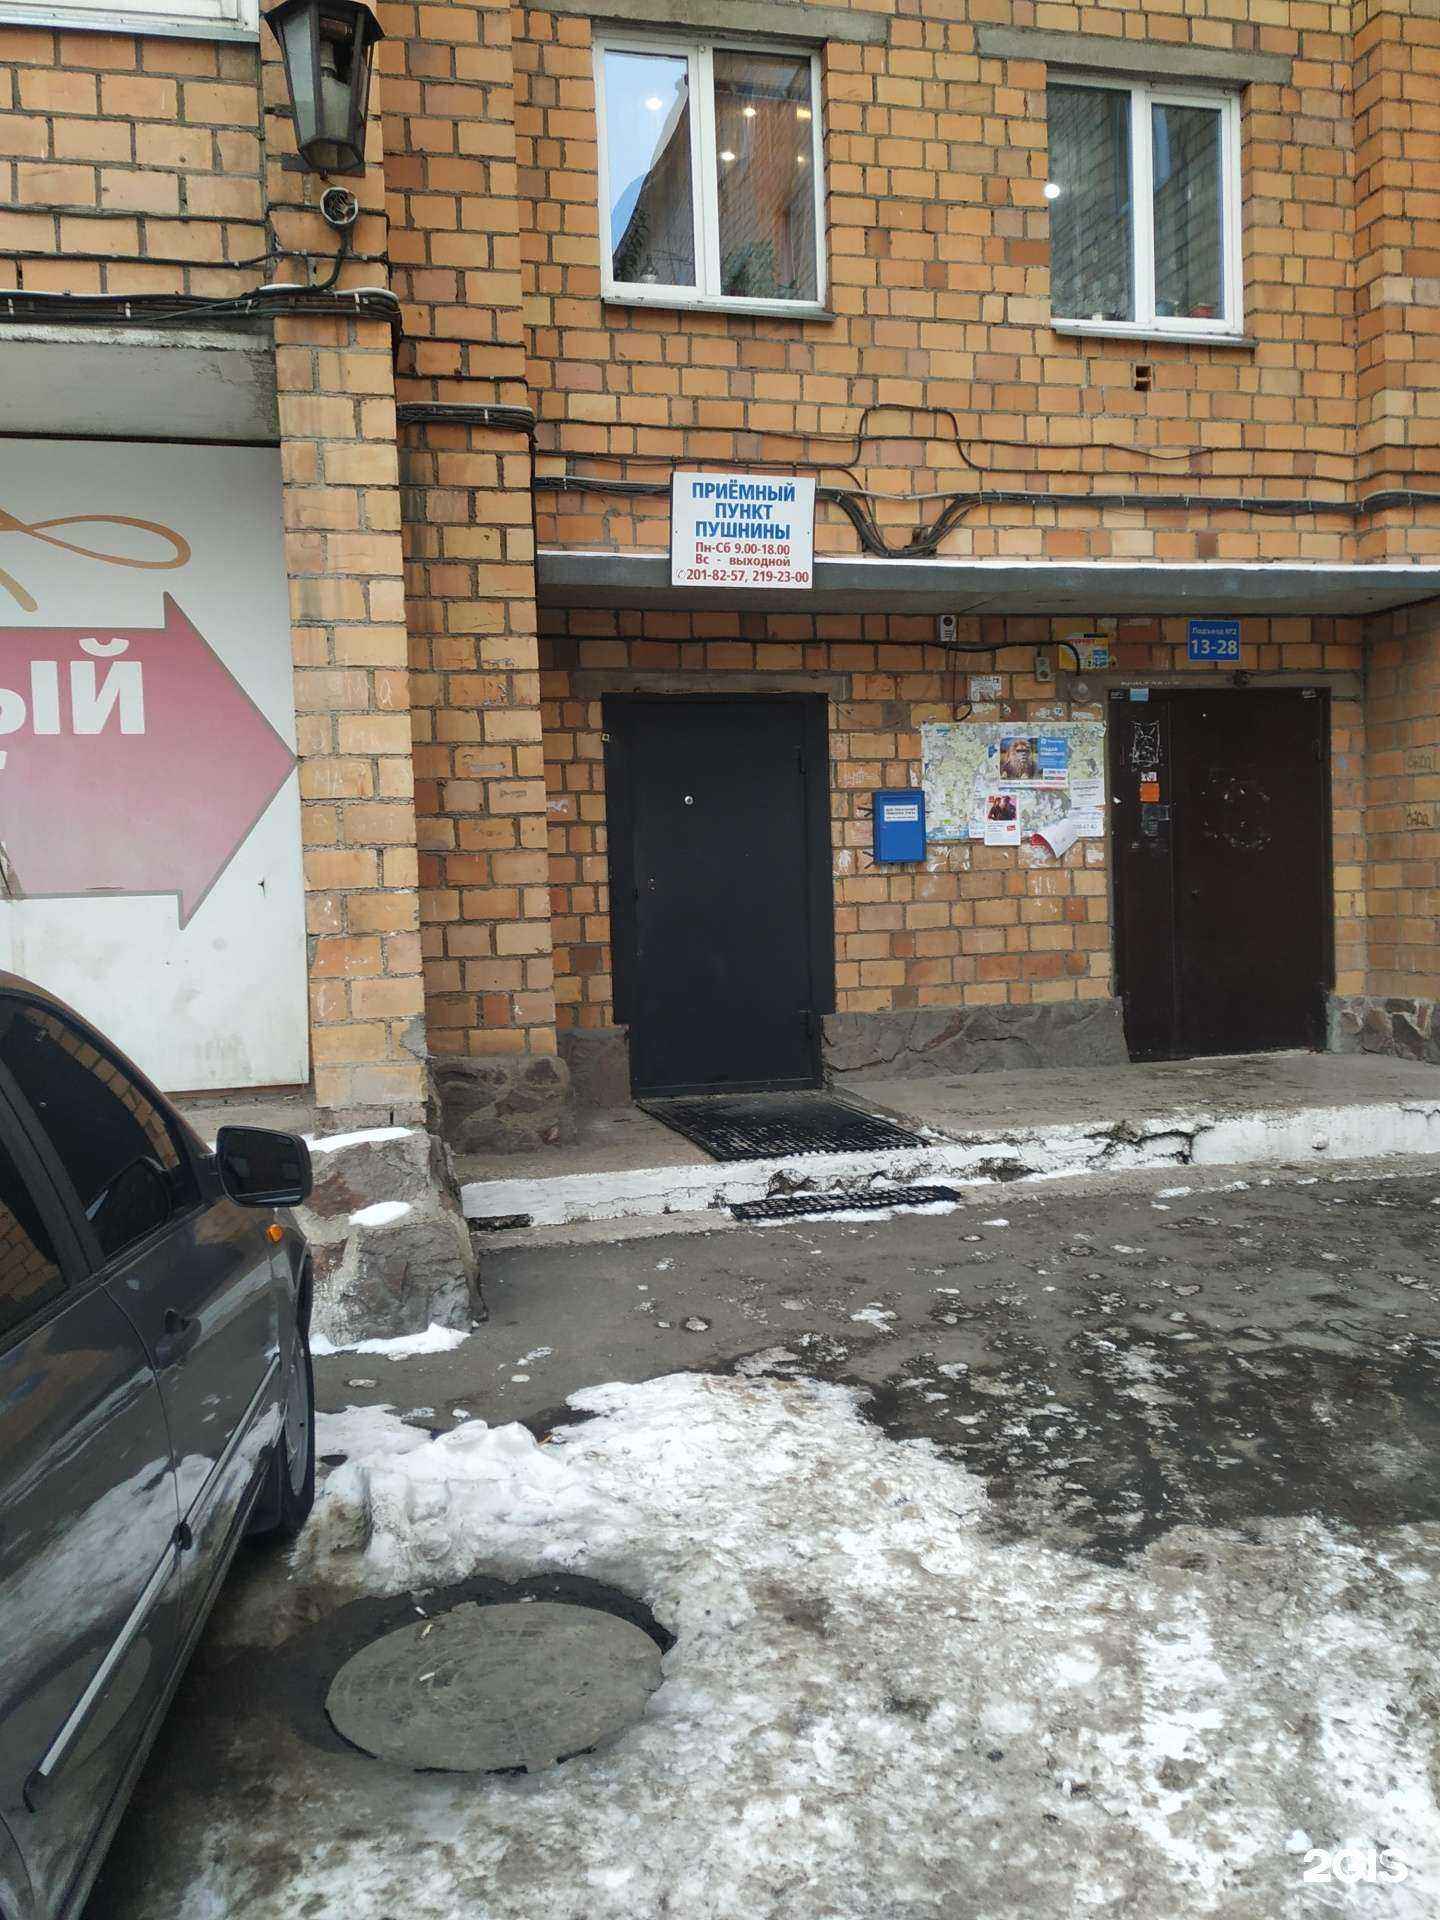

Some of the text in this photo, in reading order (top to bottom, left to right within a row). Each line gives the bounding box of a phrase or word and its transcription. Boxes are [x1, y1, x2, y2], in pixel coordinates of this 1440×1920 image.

[692, 479, 796, 502] ПРИЁМНЫЙ
[715, 502, 773, 520] ПУНКТ
[695, 521, 790, 540] ПУШНИНЫ
[695, 541, 790, 555] Пн-Сб 9.00-18.00
[695, 554, 710, 565] Вс
[729, 555, 791, 567] выходной
[686, 569, 809, 583] 201-82-57, 219-23-00
[1191, 639, 1238, 655] 13-28
